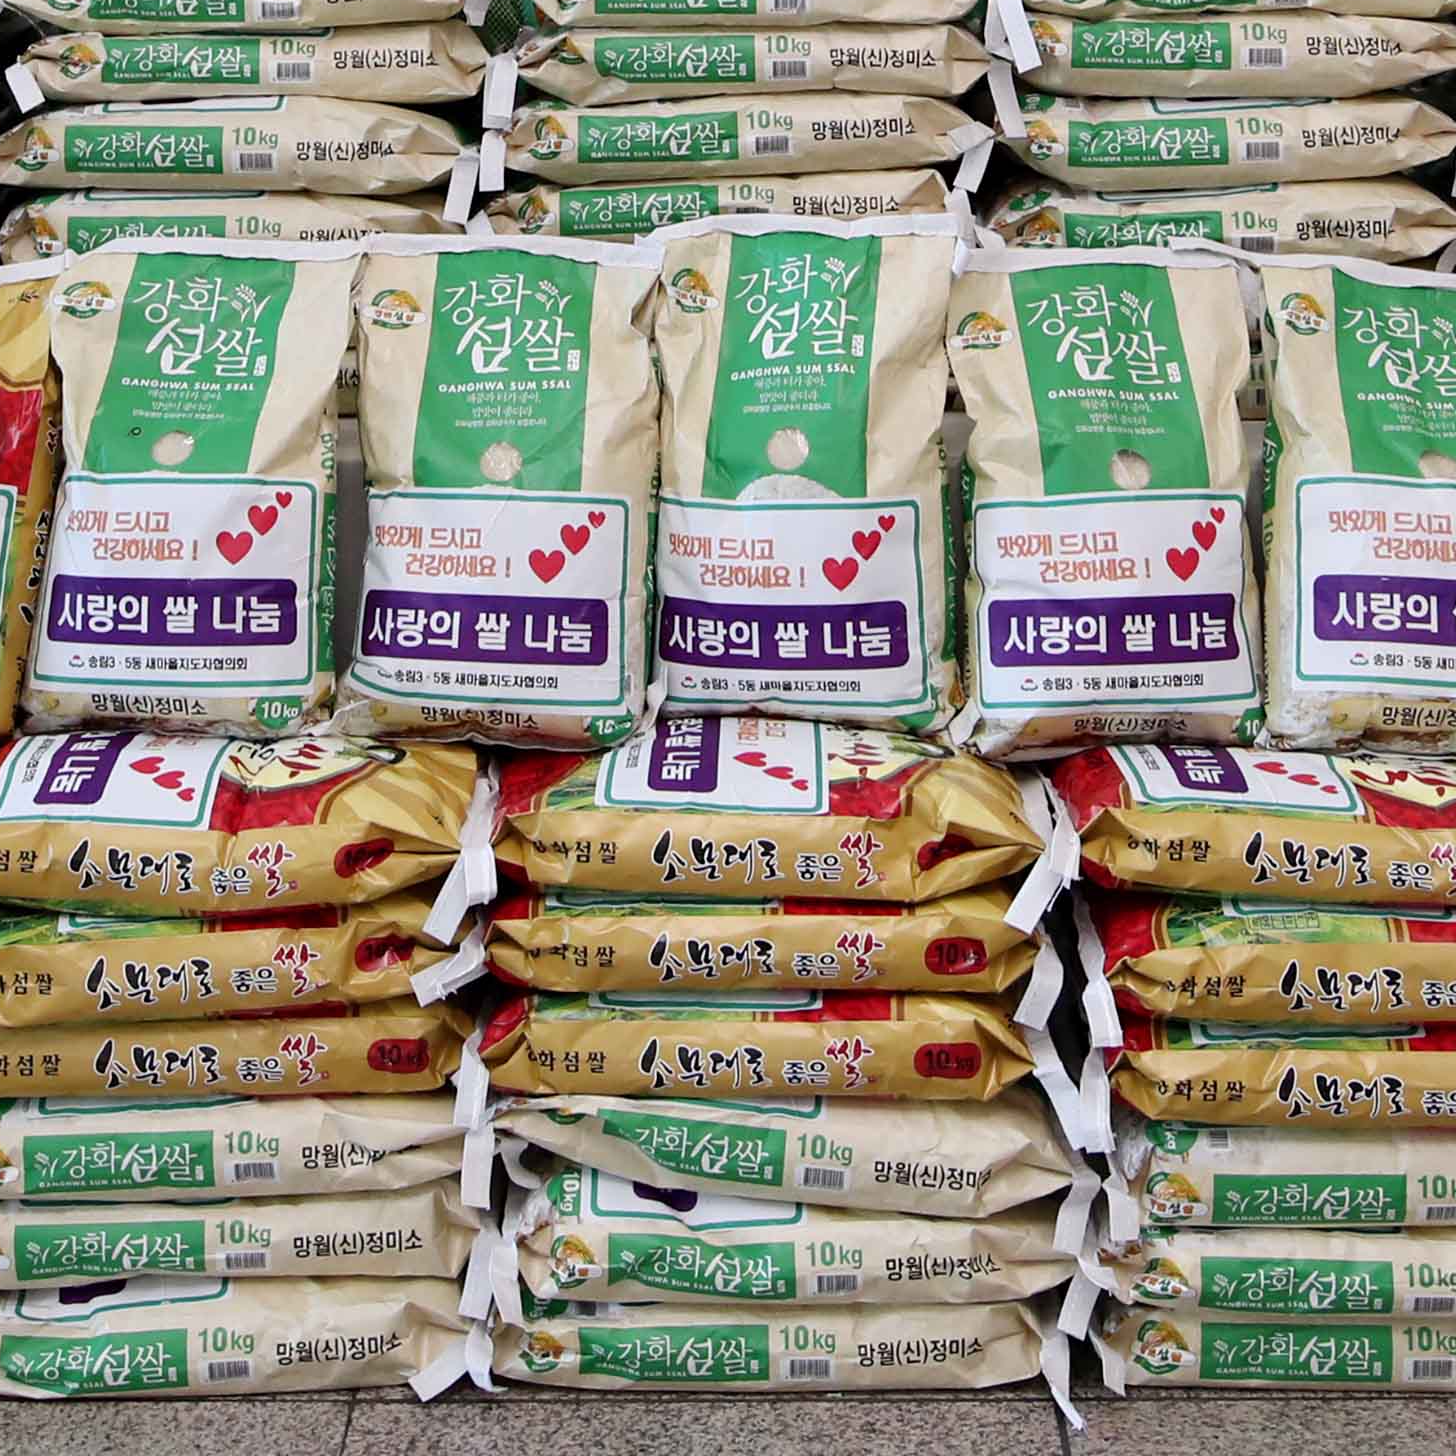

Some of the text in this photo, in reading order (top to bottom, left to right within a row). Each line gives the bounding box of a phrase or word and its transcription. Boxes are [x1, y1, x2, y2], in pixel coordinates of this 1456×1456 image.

[269, 38, 317, 58] 10kg
[763, 35, 812, 56] 10kg
[131, 276, 229, 326] 강화
[439, 273, 532, 324] 강화
[734, 254, 820, 308] 강화
[456, 316, 567, 375] 섬쌀
[748, 297, 850, 359] 섬쌀
[1341, 304, 1429, 347] 강화
[144, 321, 256, 378] 섬쌀
[507, 379, 538, 393] SUM
[373, 524, 483, 552] 맛있게 드시고
[404, 552, 497, 580] 건강하세요
[56, 589, 282, 634] 사랑의 쌀 나눔
[367, 607, 594, 654] 사랑의 쌀 나눔
[1003, 607, 1229, 656] 사랑의 쌀 나눔
[1331, 590, 1440, 636] 사랑의
[667, 614, 893, 659] 사랑의 쌀 나눔
[91, 691, 209, 719] 망월(신)정미소
[213, 1219, 273, 1248] 10kg
[777, 1325, 838, 1354] 10kg
